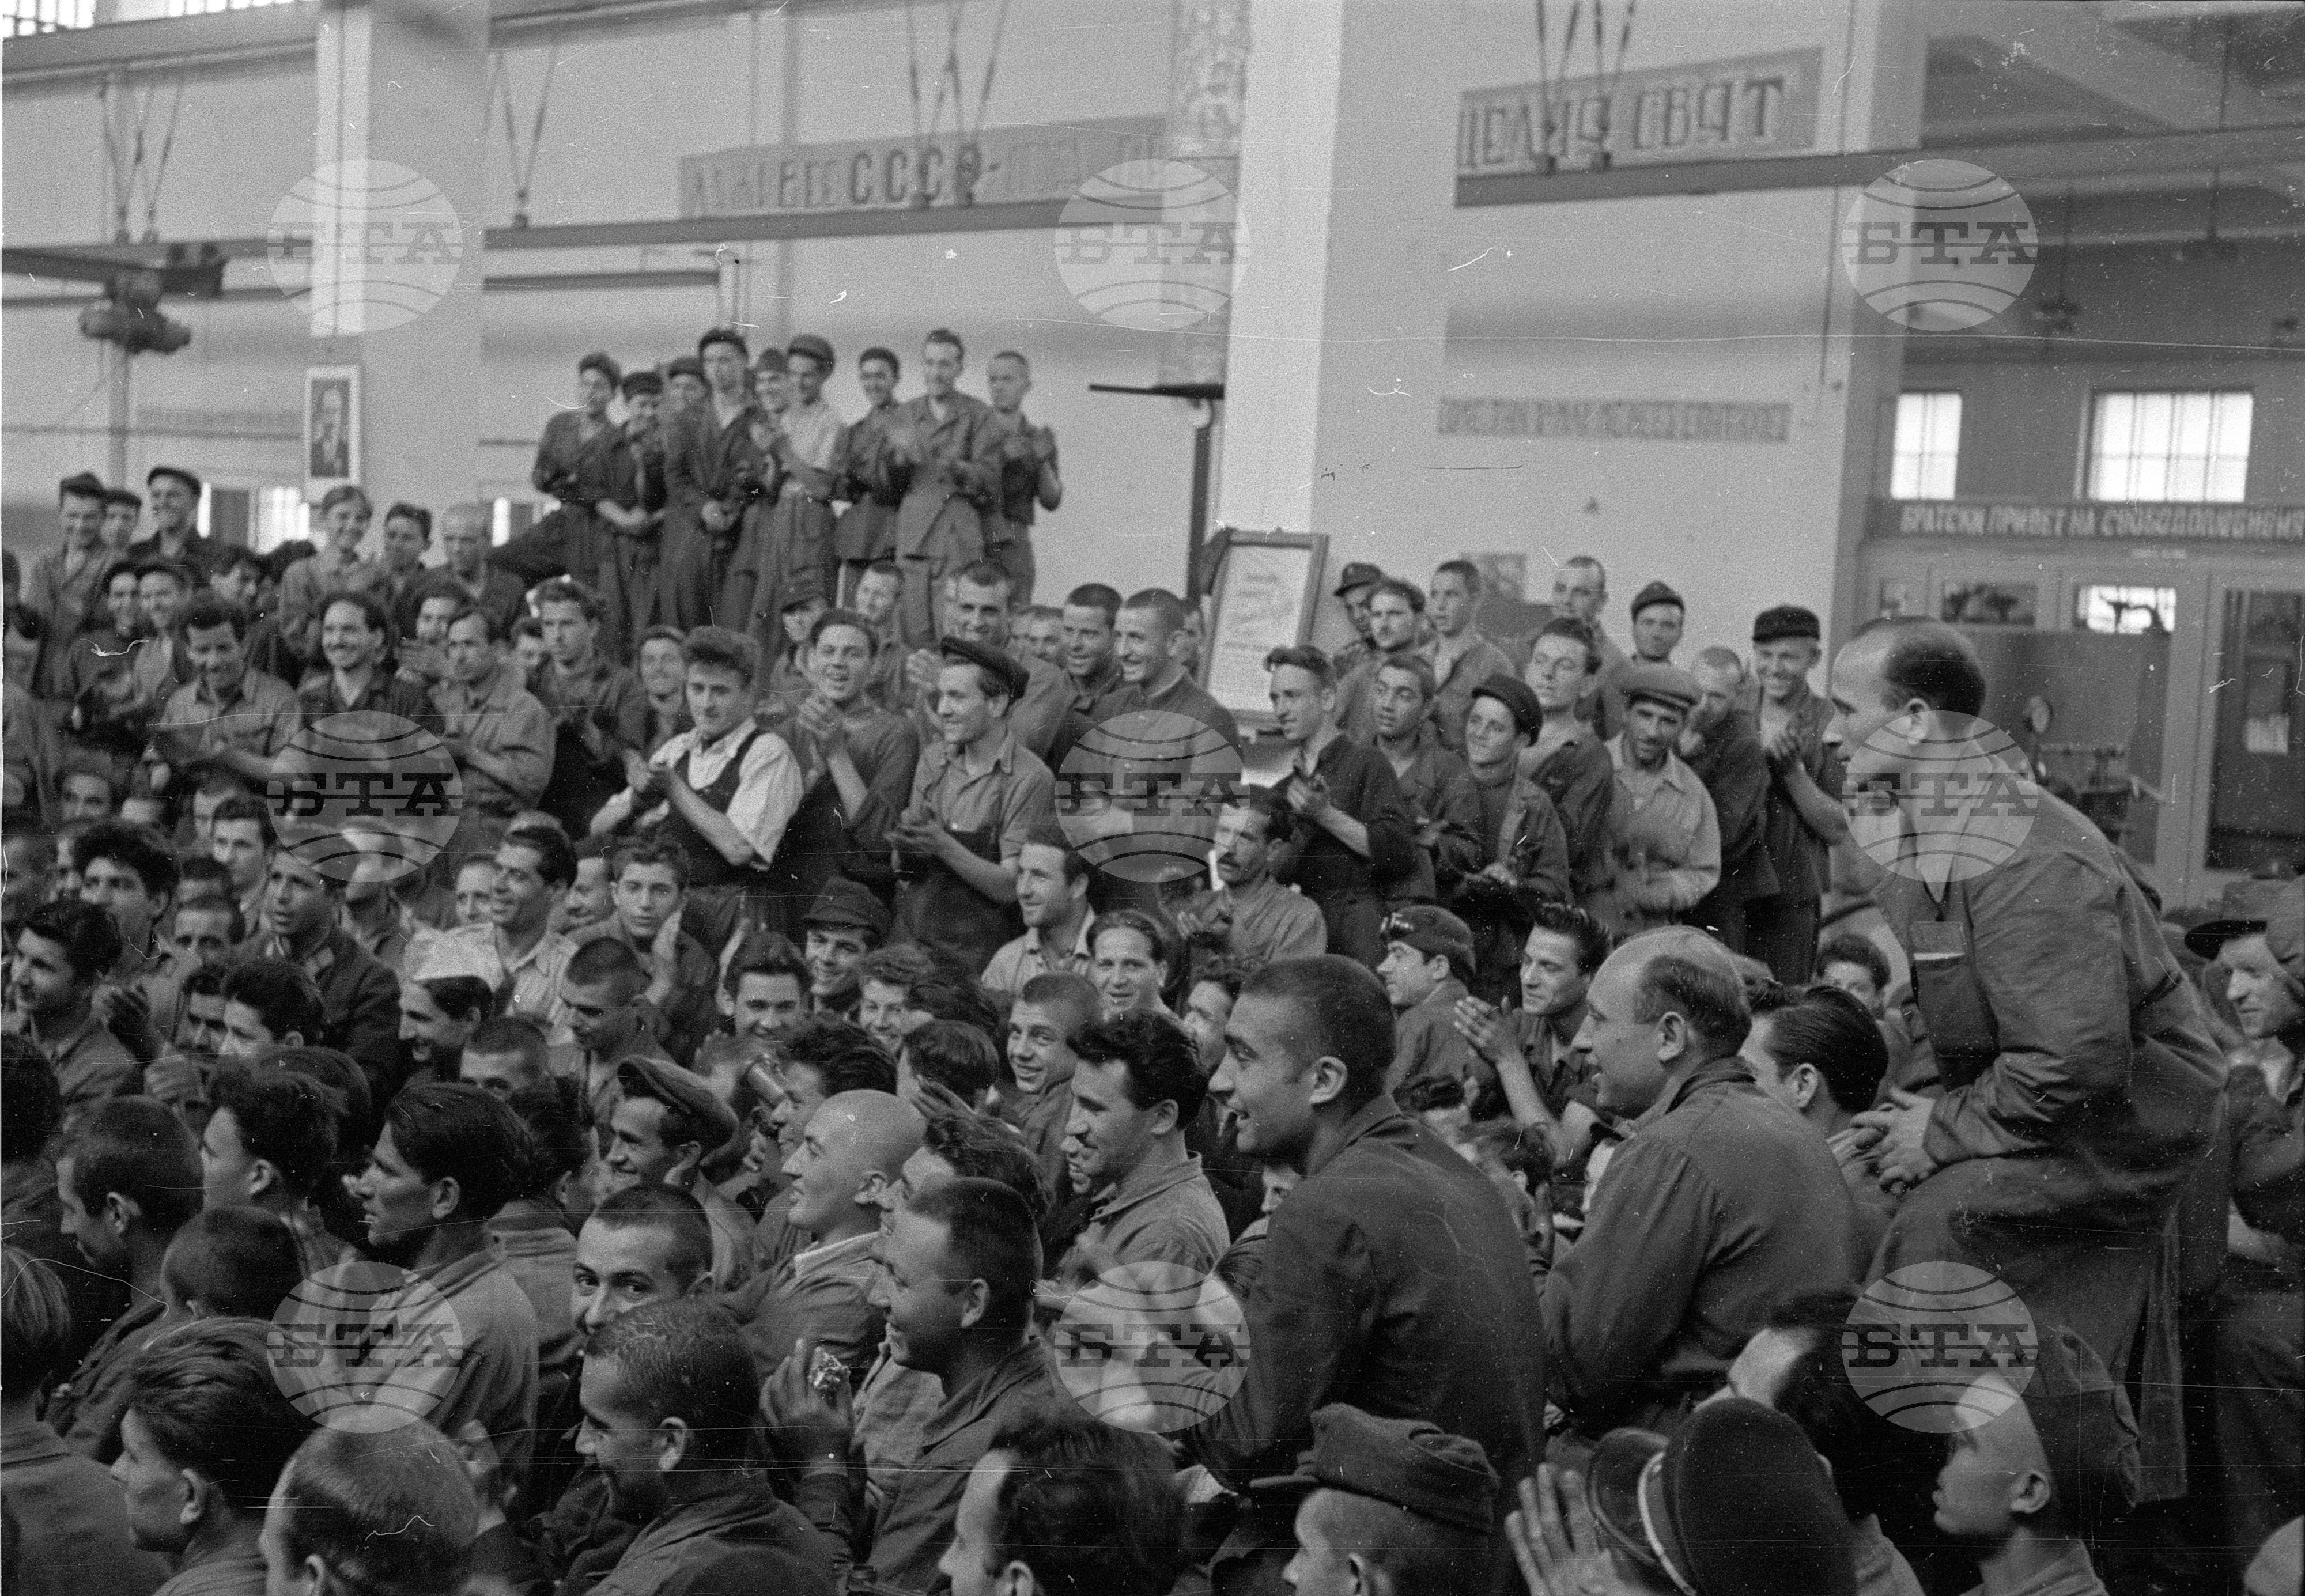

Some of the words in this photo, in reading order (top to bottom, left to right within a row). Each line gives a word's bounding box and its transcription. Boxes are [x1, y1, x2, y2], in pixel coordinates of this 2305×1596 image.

[1634, 75, 1785, 150] СВЯТ
[1900, 504, 1985, 535] БРАТСКИ
[1987, 504, 2066, 536] ПРИВЕТ
[2068, 506, 2095, 536] НА
